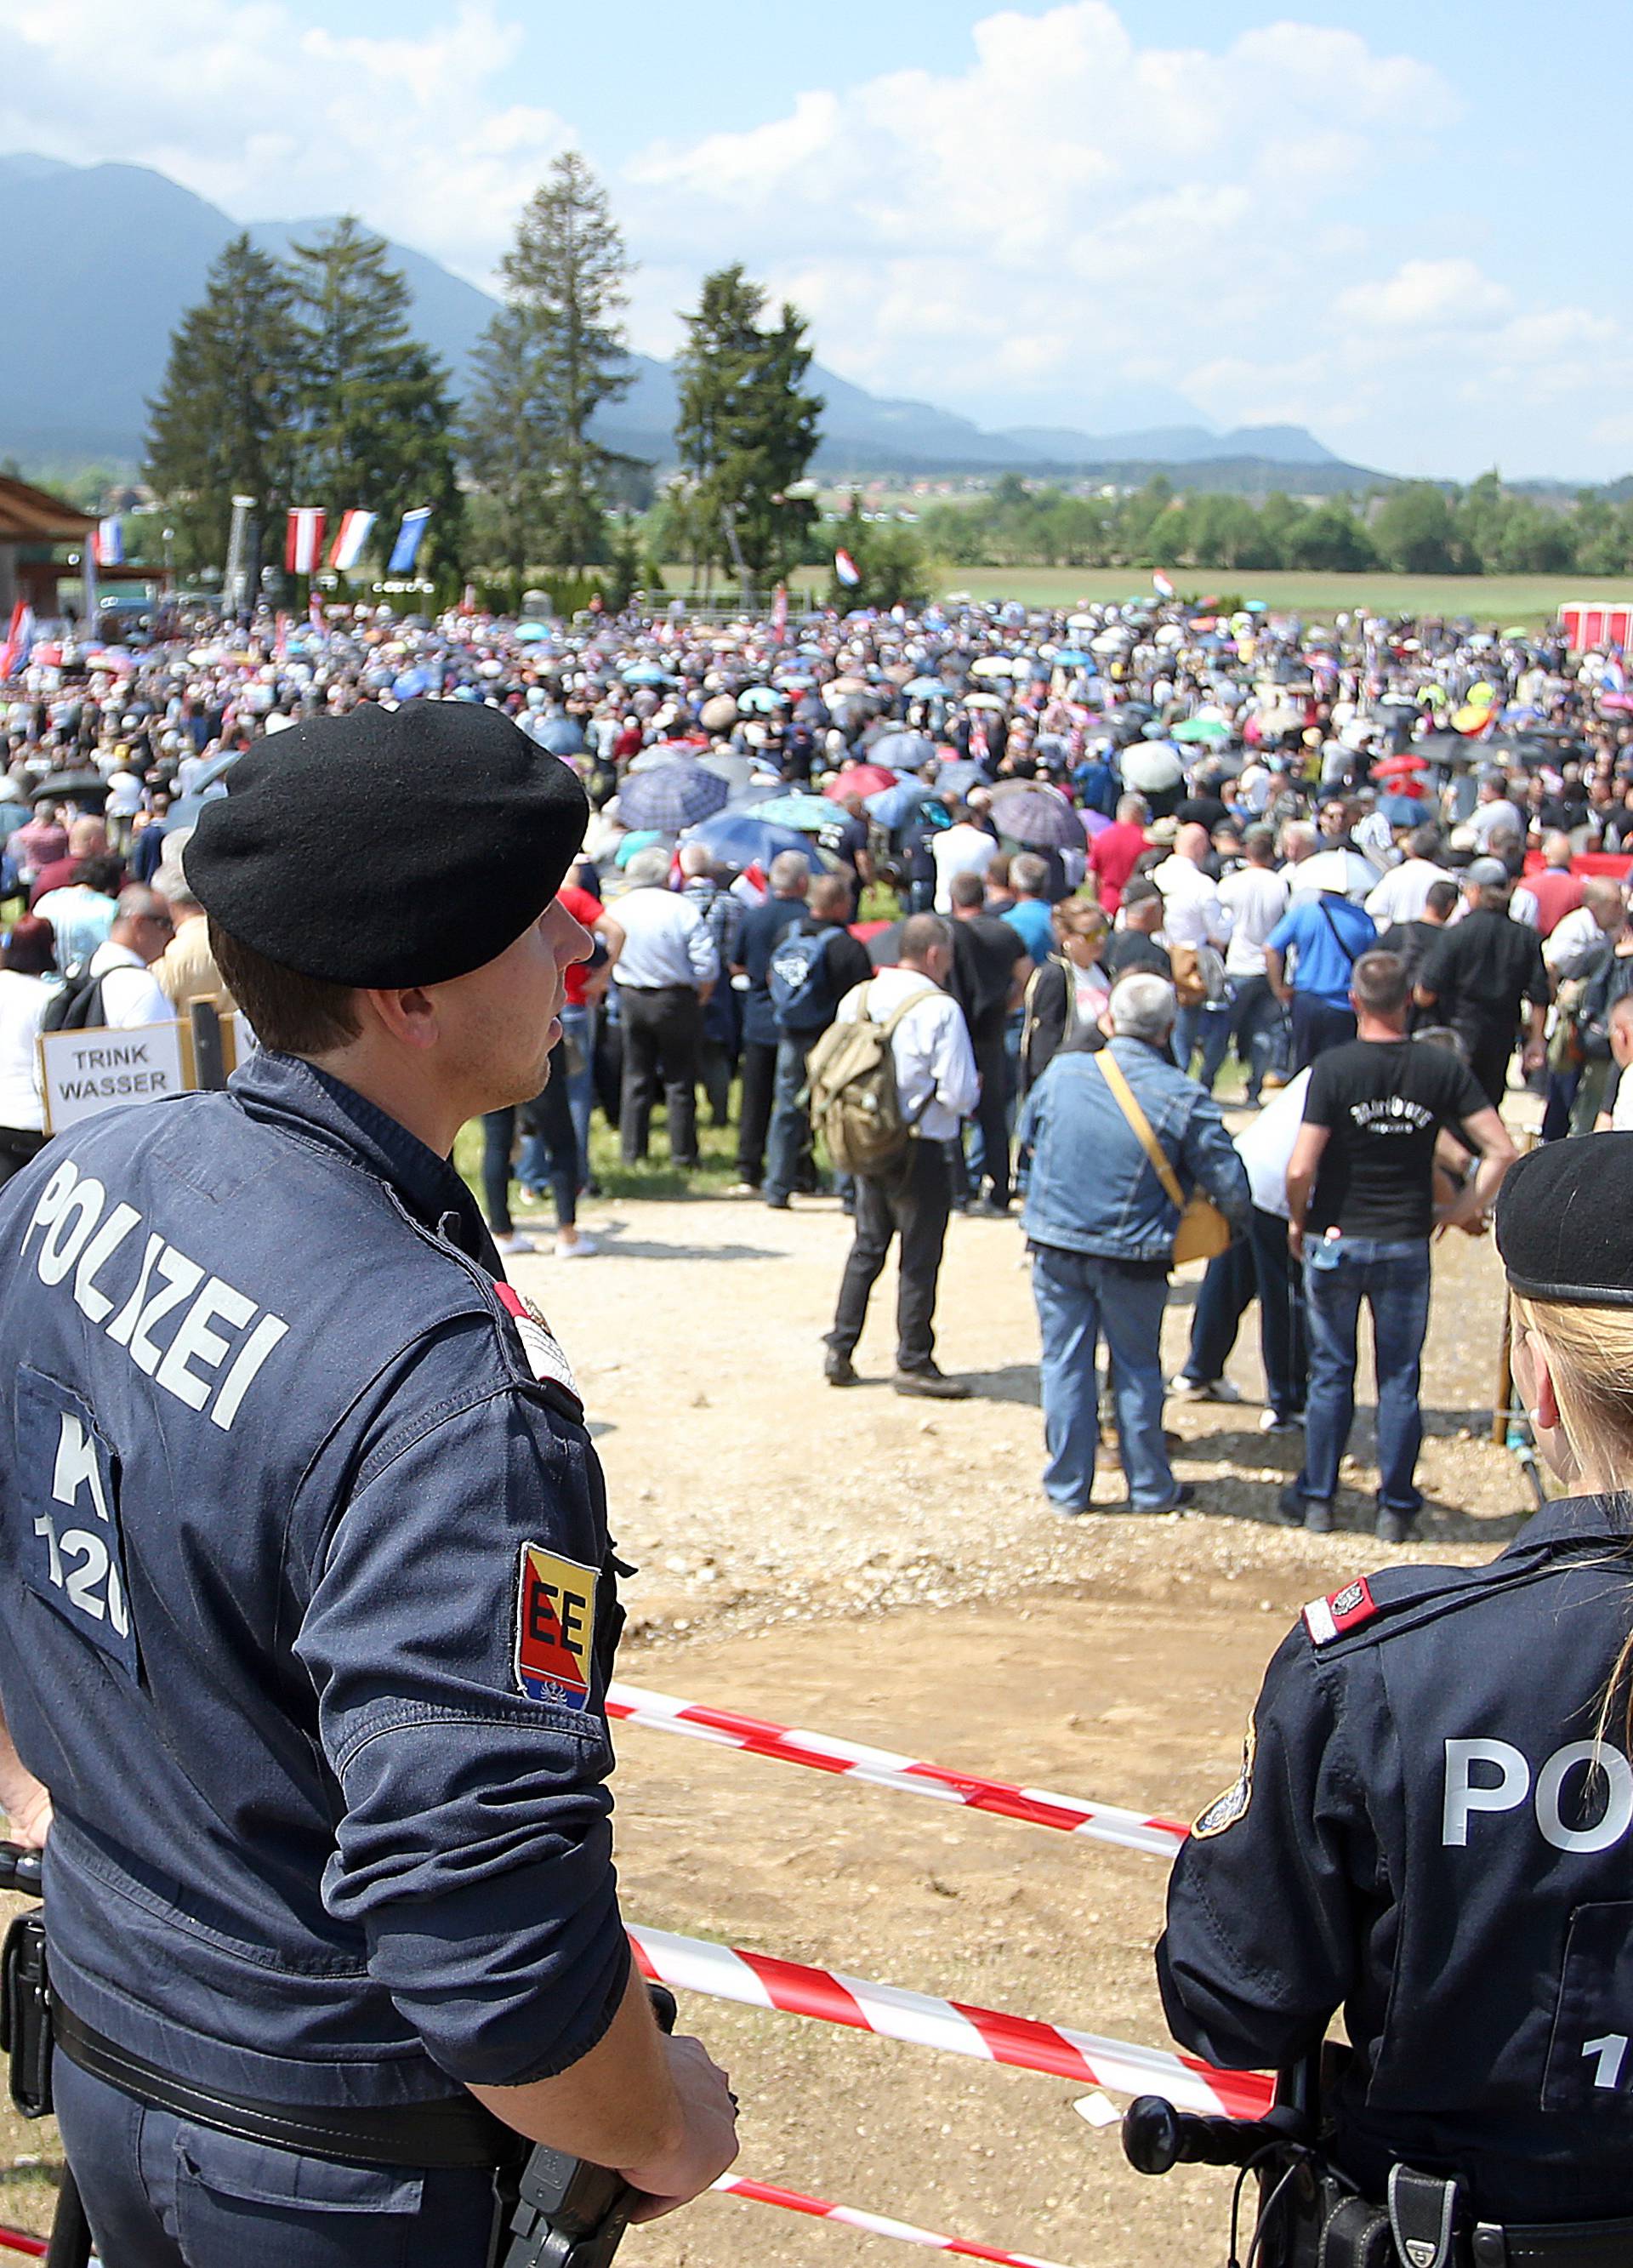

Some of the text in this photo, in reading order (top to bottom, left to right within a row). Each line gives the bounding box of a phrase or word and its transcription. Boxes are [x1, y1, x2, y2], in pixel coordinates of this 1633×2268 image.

[72, 1044, 149, 1070] TRINK
[59, 1072, 168, 1101] WASSER
[21, 1159, 290, 1432] POLIZEI
[530, 1580, 586, 1656] EE
[1582, 2033, 1633, 2091] 1
